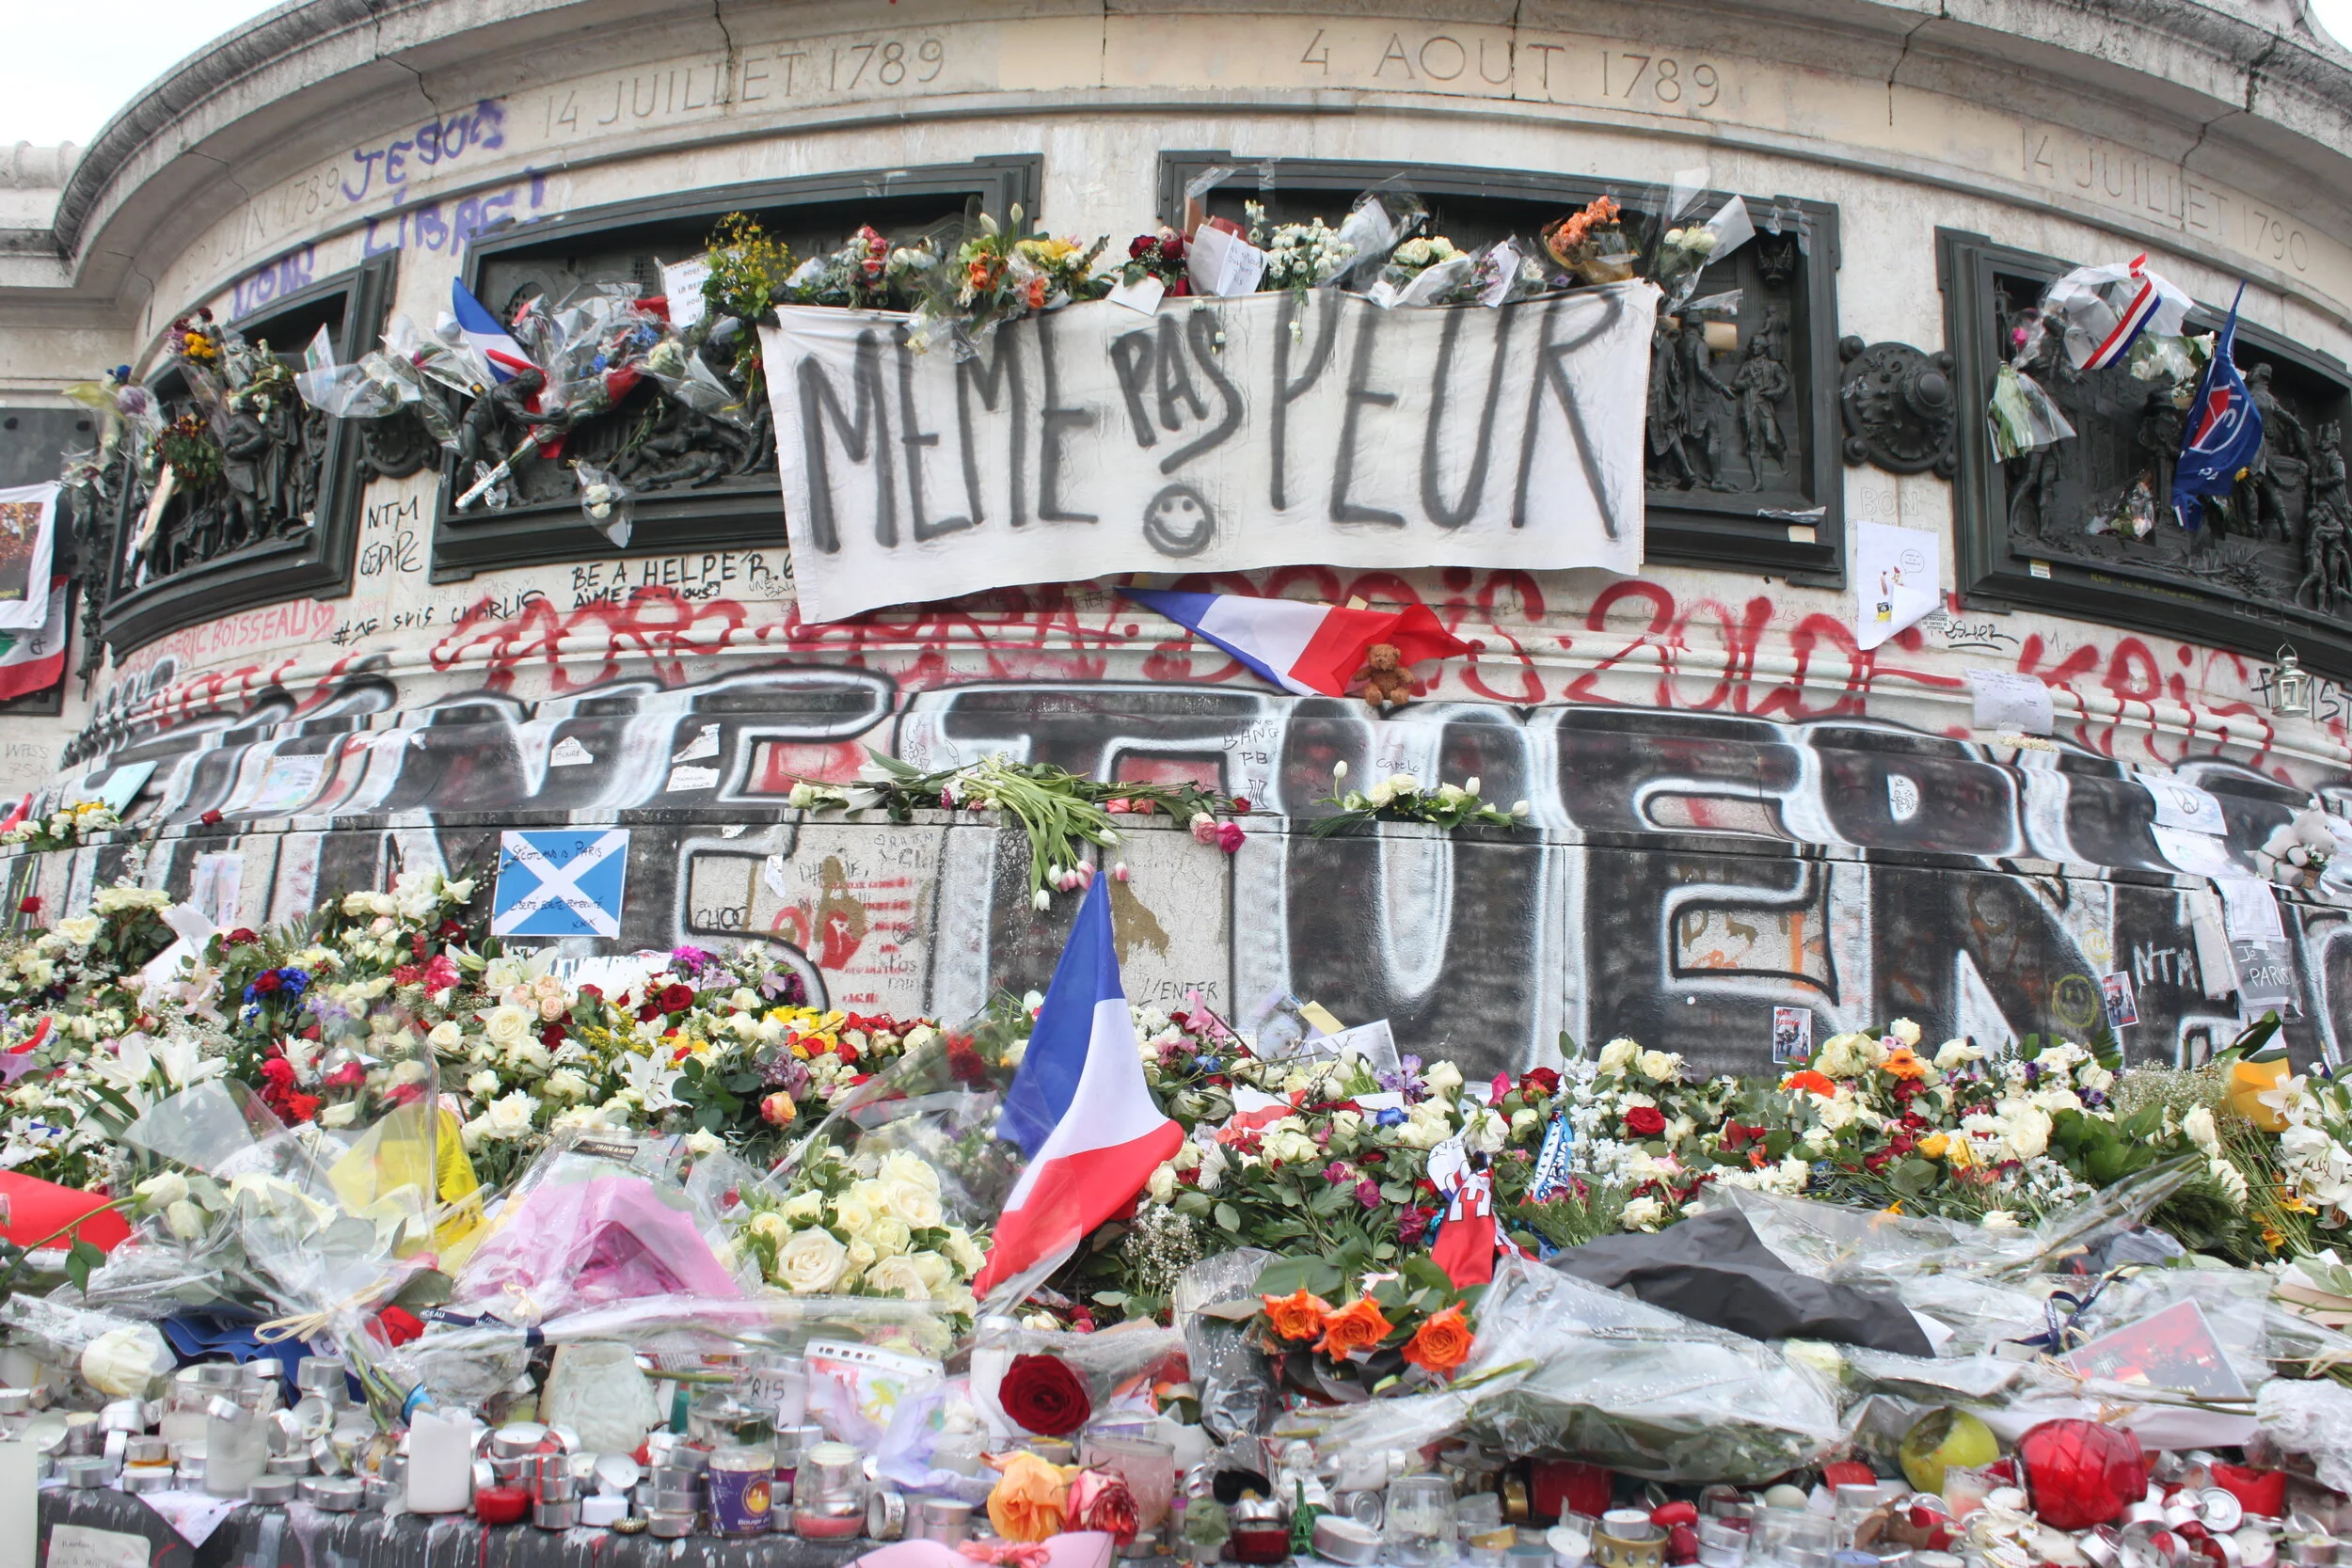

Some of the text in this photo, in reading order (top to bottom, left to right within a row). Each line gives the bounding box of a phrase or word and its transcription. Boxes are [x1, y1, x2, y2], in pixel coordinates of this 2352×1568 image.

[543, 39, 945, 138] 14 JUILLET 1789
[1300, 28, 1720, 108] 4 AOUT 1789
[280, 166, 341, 228] 1789
[2021, 127, 2310, 274] 14 JUILLET 1790
[1110, 308, 1244, 474] PAS
[1270, 287, 1625, 539] PEUR
[368, 496, 419, 531] NTM
[1860, 486, 1919, 517] BON
[571, 562, 604, 591] BE
[612, 561, 628, 585] A
[1221, 727, 1280, 751] BANG
[1237, 751, 1268, 767] FB
[574, 840, 602, 858] PARIS
[2133, 941, 2199, 993] NTM
